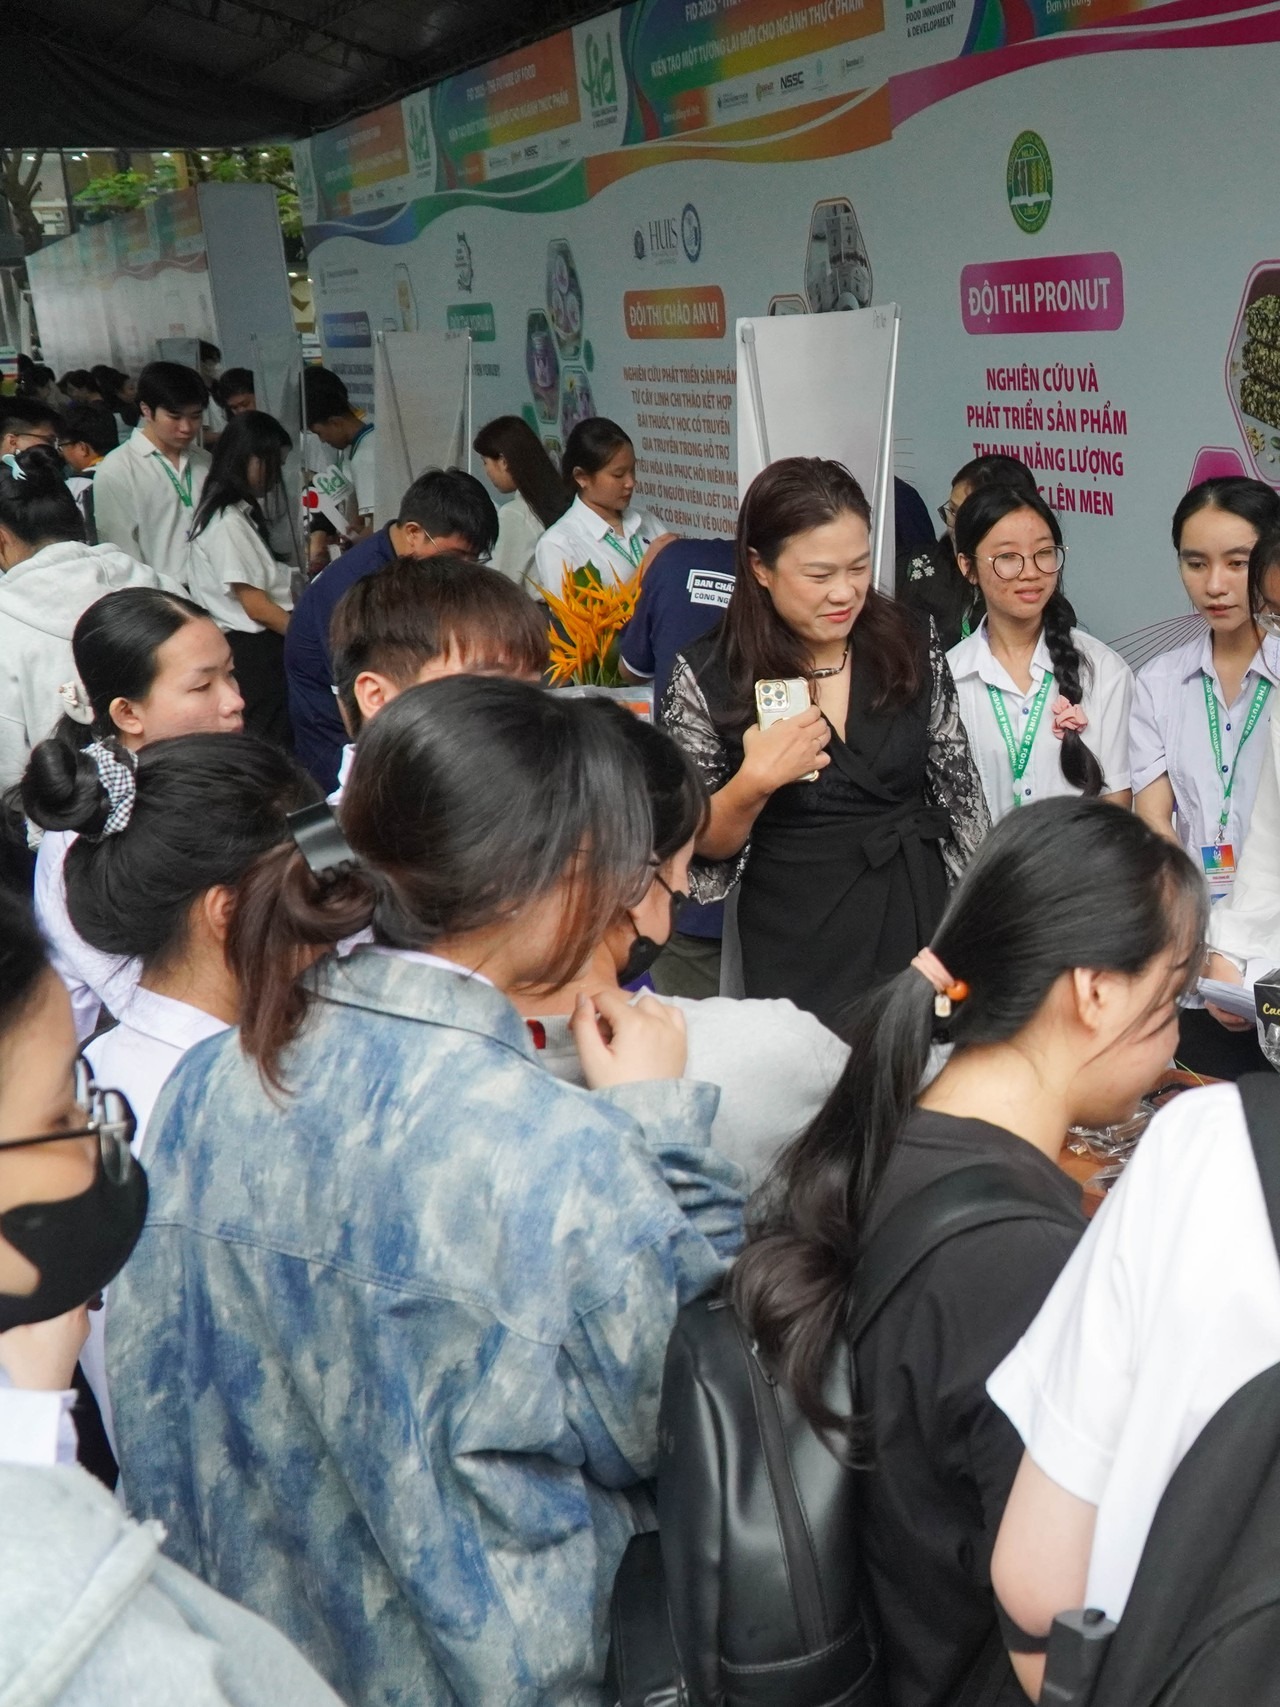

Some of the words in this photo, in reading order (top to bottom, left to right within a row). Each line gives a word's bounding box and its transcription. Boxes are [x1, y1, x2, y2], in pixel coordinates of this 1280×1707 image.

[780, 72, 804, 90] NSSC
[968, 280, 1000, 322] ĐỘI
[1001, 282, 1030, 314] THI
[1034, 277, 1111, 312] PRONUT
[630, 301, 646, 332] ĐỘI
[646, 305, 662, 326] THI
[693, 302, 706, 325] AN
[708, 302, 719, 331] VỊ
[986, 364, 1040, 392] NGHIÊN
[1042, 363, 1075, 392] CỨU
[1076, 363, 1098, 392] VÀ
[967, 401, 1001, 428] PHÁT
[1003, 399, 1044, 431] TRIỂN
[1047, 402, 1077, 432] SẢN
[1080, 402, 1127, 435] PHẨM
[1023, 442, 1065, 472] NĂNG
[1069, 447, 1124, 482] LƯỢNG
[726, 470, 738, 489] MẠ
[1049, 484, 1077, 513] LÊN
[1079, 489, 1114, 516] MEN
[694, 579, 714, 588] BAN
[718, 596, 728, 604] NG
[990, 684, 1004, 716] DEVERLO
[1039, 683, 1049, 697] THE
[1205, 674, 1216, 720] DEVERLOPM
[1256, 685, 1267, 702] THE
[1029, 699, 1042, 732] FUTURE
[1244, 703, 1260, 734] FUTURE
[1024, 735, 1032, 746] OF
[1018, 748, 1029, 770] FOOD
